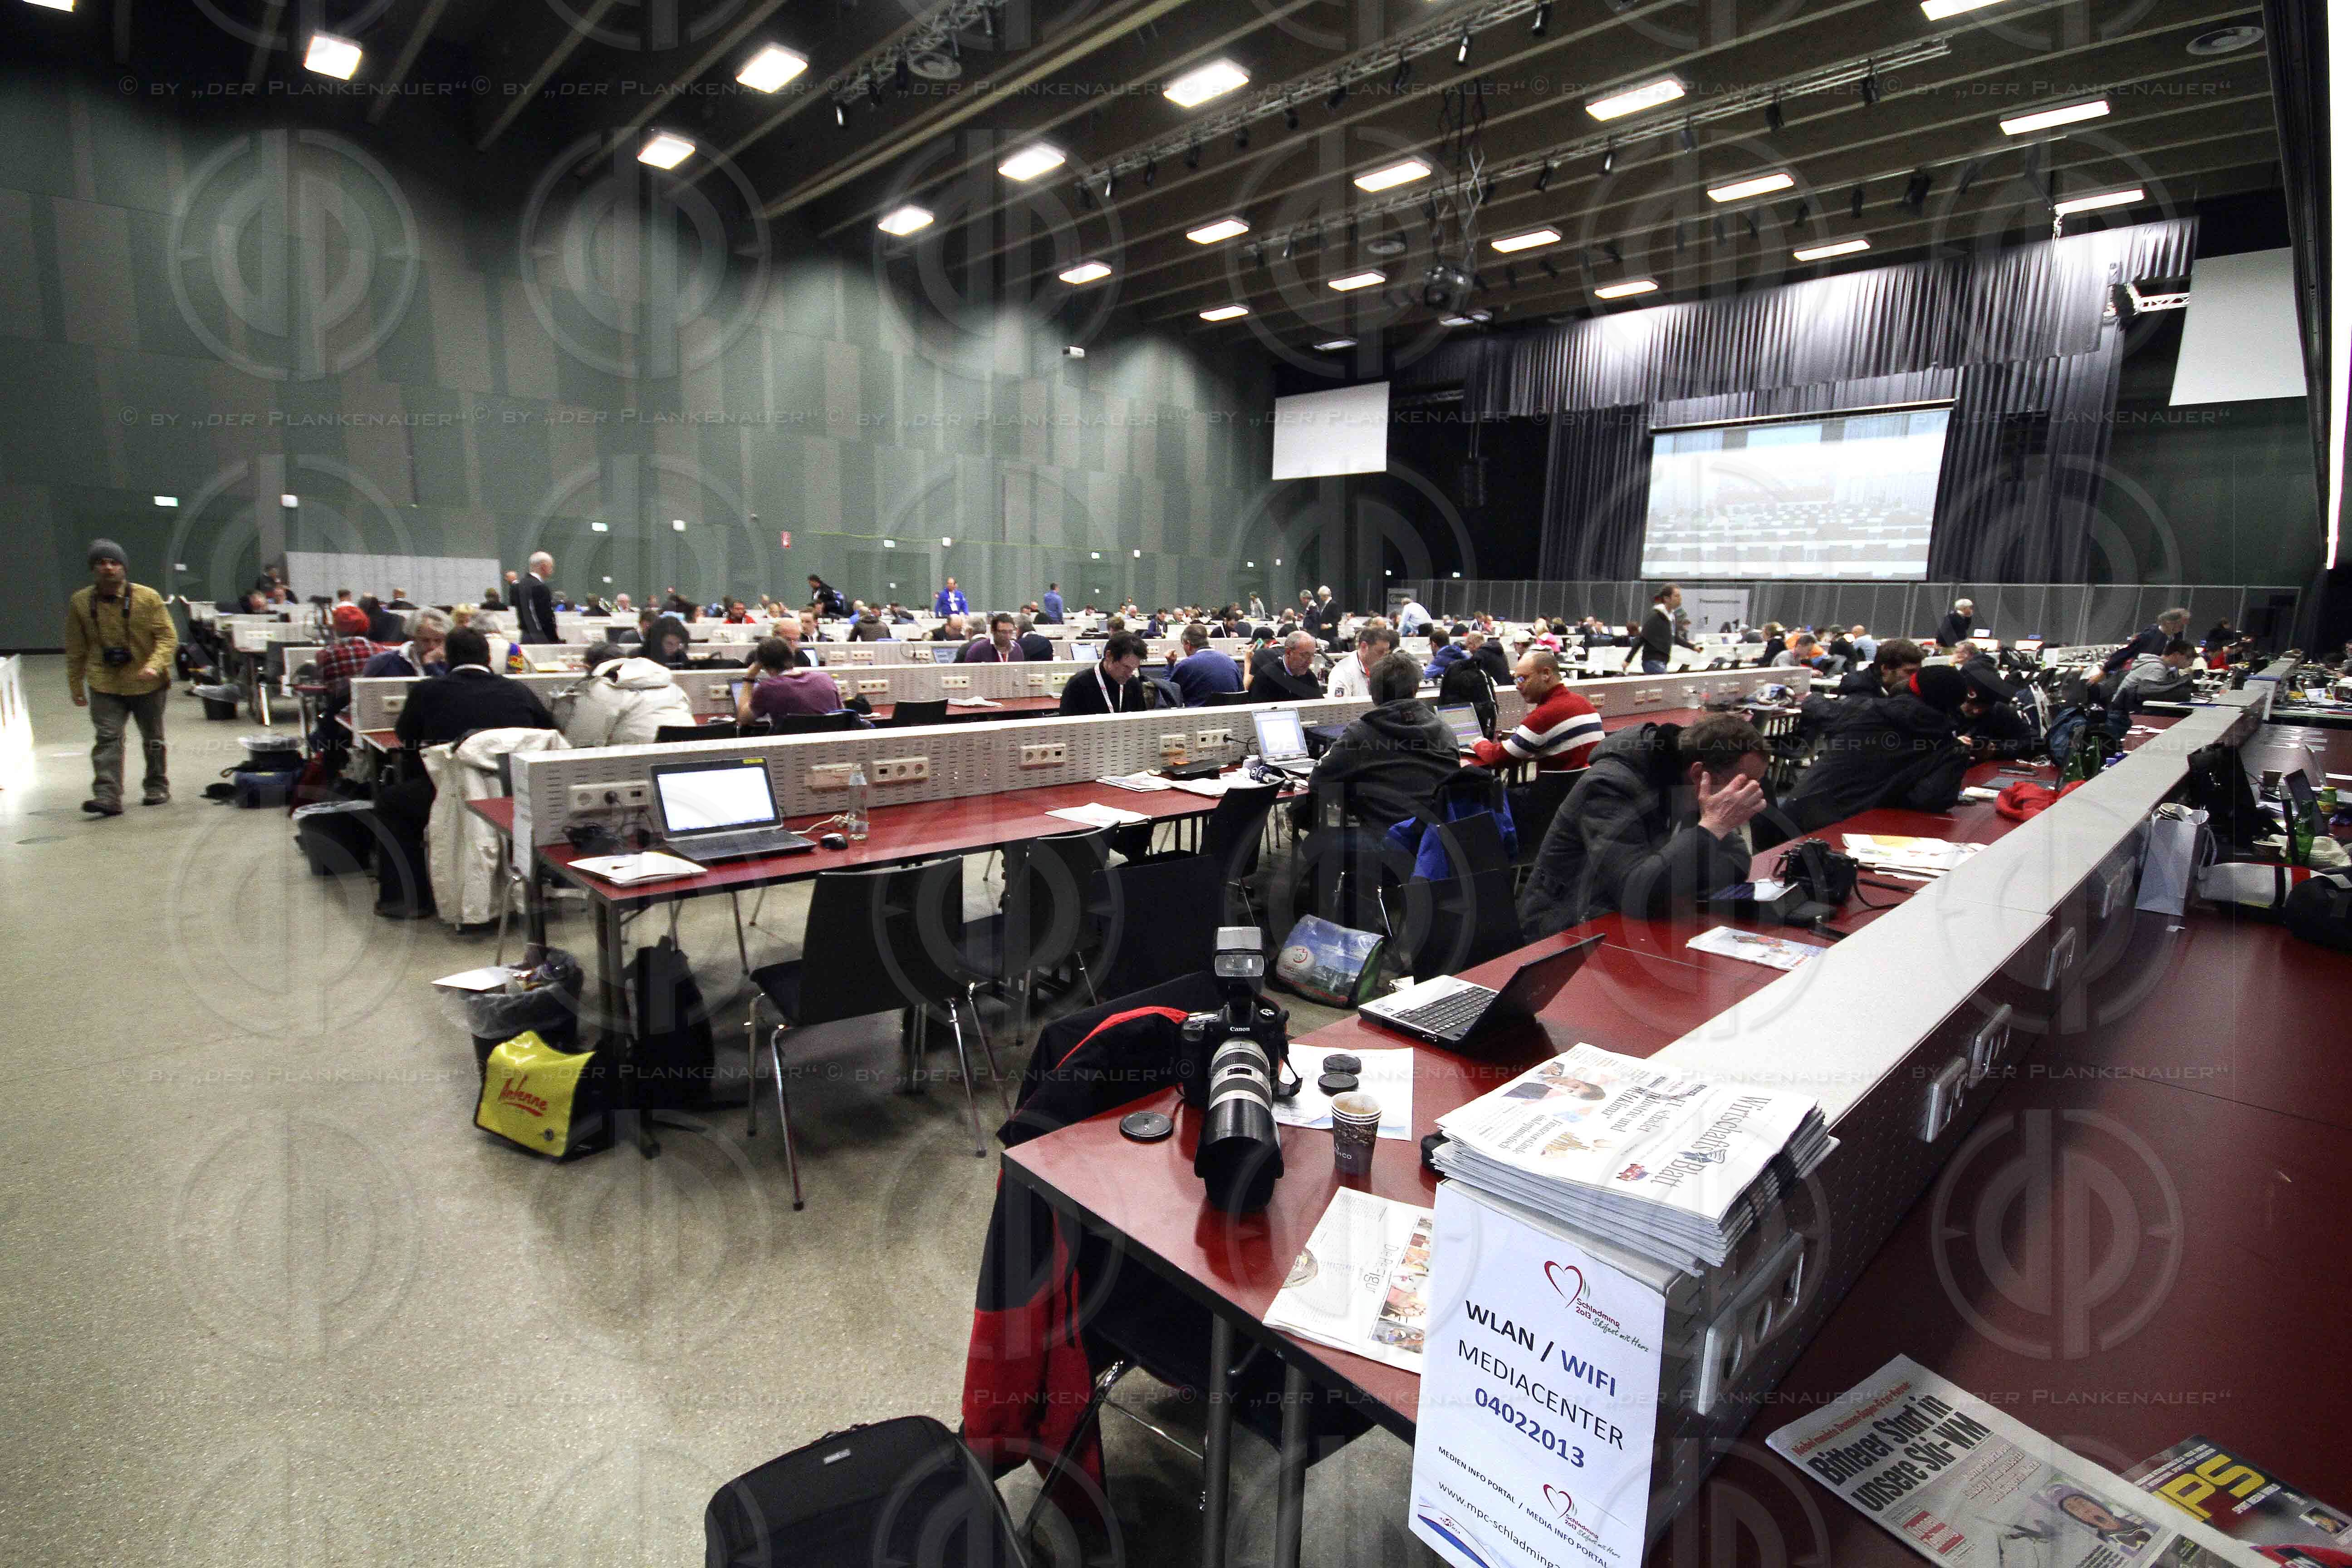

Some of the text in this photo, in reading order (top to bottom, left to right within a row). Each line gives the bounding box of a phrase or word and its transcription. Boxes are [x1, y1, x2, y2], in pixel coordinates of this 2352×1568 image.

[1609, 1117, 1633, 1132] und
[1465, 1300, 1534, 1351] WLAN
[1562, 1350, 1616, 1397] WIFI
[1575, 1307, 1649, 1352] 2013 Skifest mit Herz
[1577, 1298, 1620, 1329] Schladming
[1458, 1339, 1623, 1450] MEDIACENTER
[1475, 1387, 1585, 1469] 04022013
[1807, 1393, 1954, 1486] Bitterer Start in
[1439, 1447, 1467, 1472] MEDIEN
[1467, 1465, 1486, 1482] INFO
[1488, 1480, 1515, 1504] PORTAL
[1526, 1508, 1553, 1532] MEDIA
[1554, 1527, 1575, 1545] INFO
[1577, 1543, 1608, 1568] PORTAL
[1851, 1459, 1929, 1512] unsere
[1910, 1411, 1993, 1475] Ski-WM
